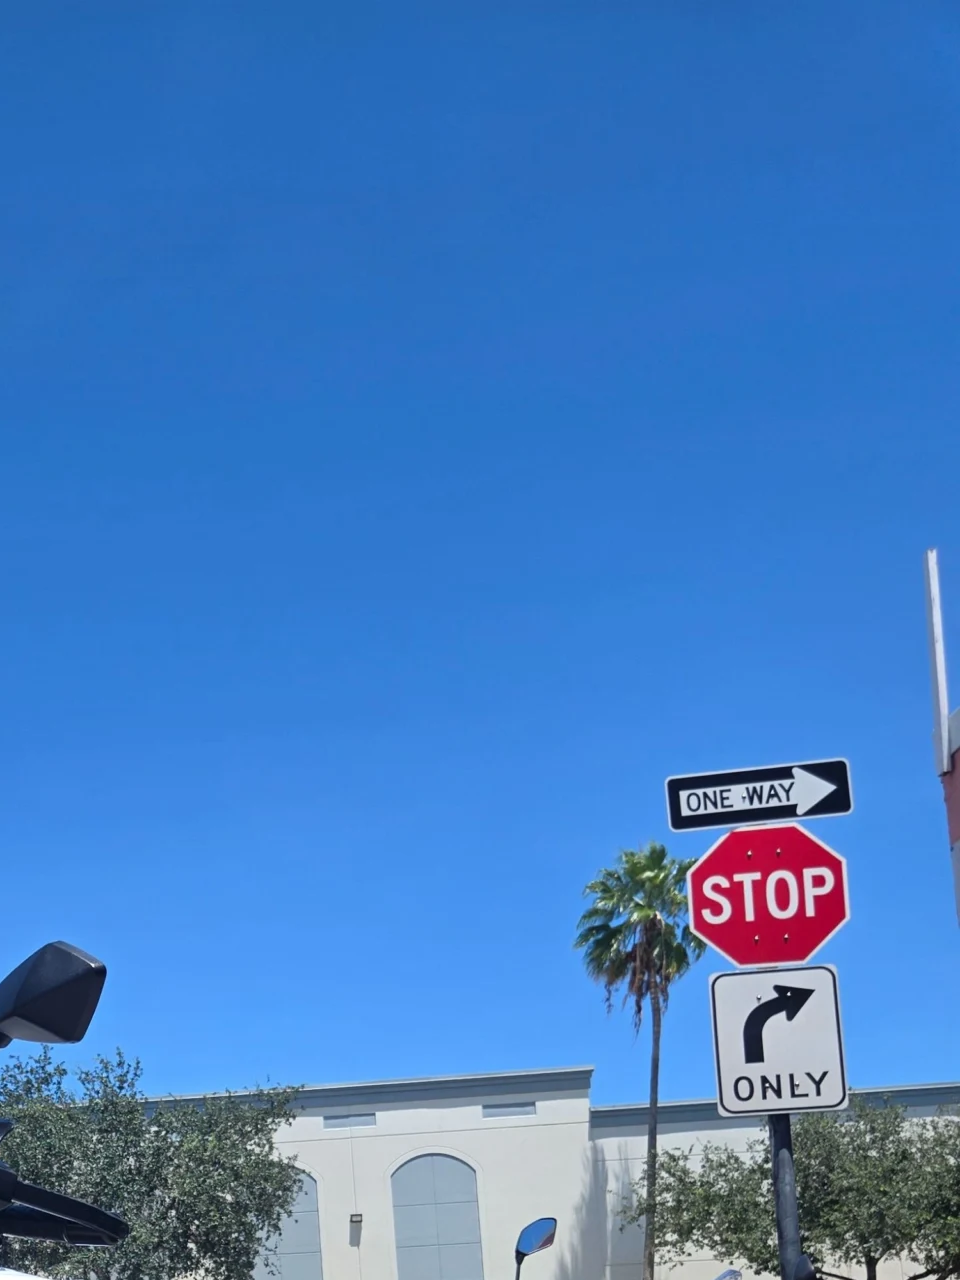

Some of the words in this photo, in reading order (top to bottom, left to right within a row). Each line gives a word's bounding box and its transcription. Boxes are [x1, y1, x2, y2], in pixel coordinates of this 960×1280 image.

[686, 788, 734, 813] ONE
[745, 781, 795, 806] WAY
[700, 866, 835, 925] STOP
[732, 1070, 829, 1102] ONLY
